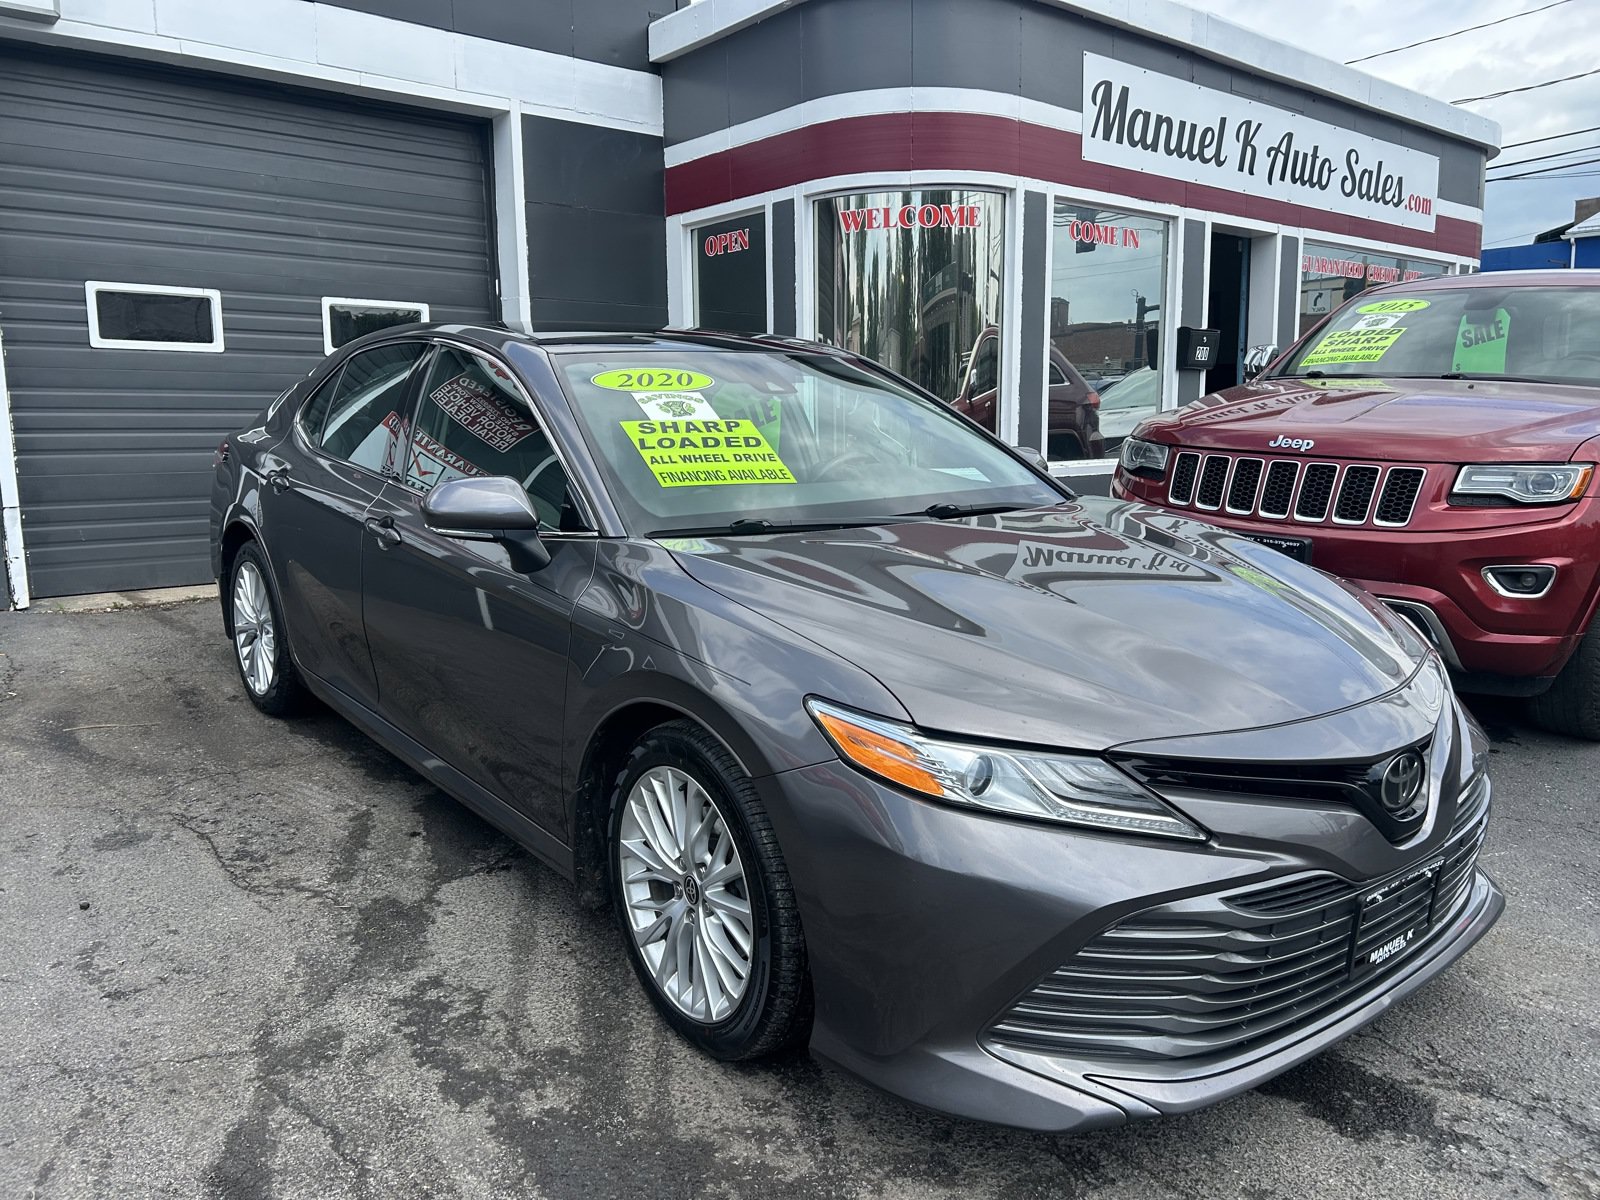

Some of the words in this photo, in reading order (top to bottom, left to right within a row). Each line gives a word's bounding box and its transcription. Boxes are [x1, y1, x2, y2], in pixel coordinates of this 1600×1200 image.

[1090, 80, 1228, 168] Manuel
[1235, 119, 1263, 176] K
[1266, 131, 1337, 191] Auto
[839, 203, 982, 233] WELCOME
[704, 228, 750, 257] OPEN
[1069, 219, 1119, 246] COME
[1121, 229, 1141, 250] IN
[1301, 255, 1365, 279] GUARANTEED
[1366, 264, 1401, 284] CREDIT
[1324, 336, 1391, 347] SHARP
[1326, 328, 1403, 340] LOADED
[1461, 319, 1505, 348] SALE
[1195, 346, 1210, 360] 200
[617, 372, 694, 388] 2020
[638, 420, 741, 435] SHARP
[638, 436, 762, 450] LOADED
[1269, 434, 1315, 451] Jeep
[650, 456, 679, 465] ALL
[679, 453, 730, 463] WHEEL
[733, 453, 778, 462] DRIVE
[659, 470, 728, 484] FINANCING
[729, 468, 791, 481] AVAILABLE
[1369, 934, 1406, 963] MANUEL
[1406, 928, 1415, 941] K
